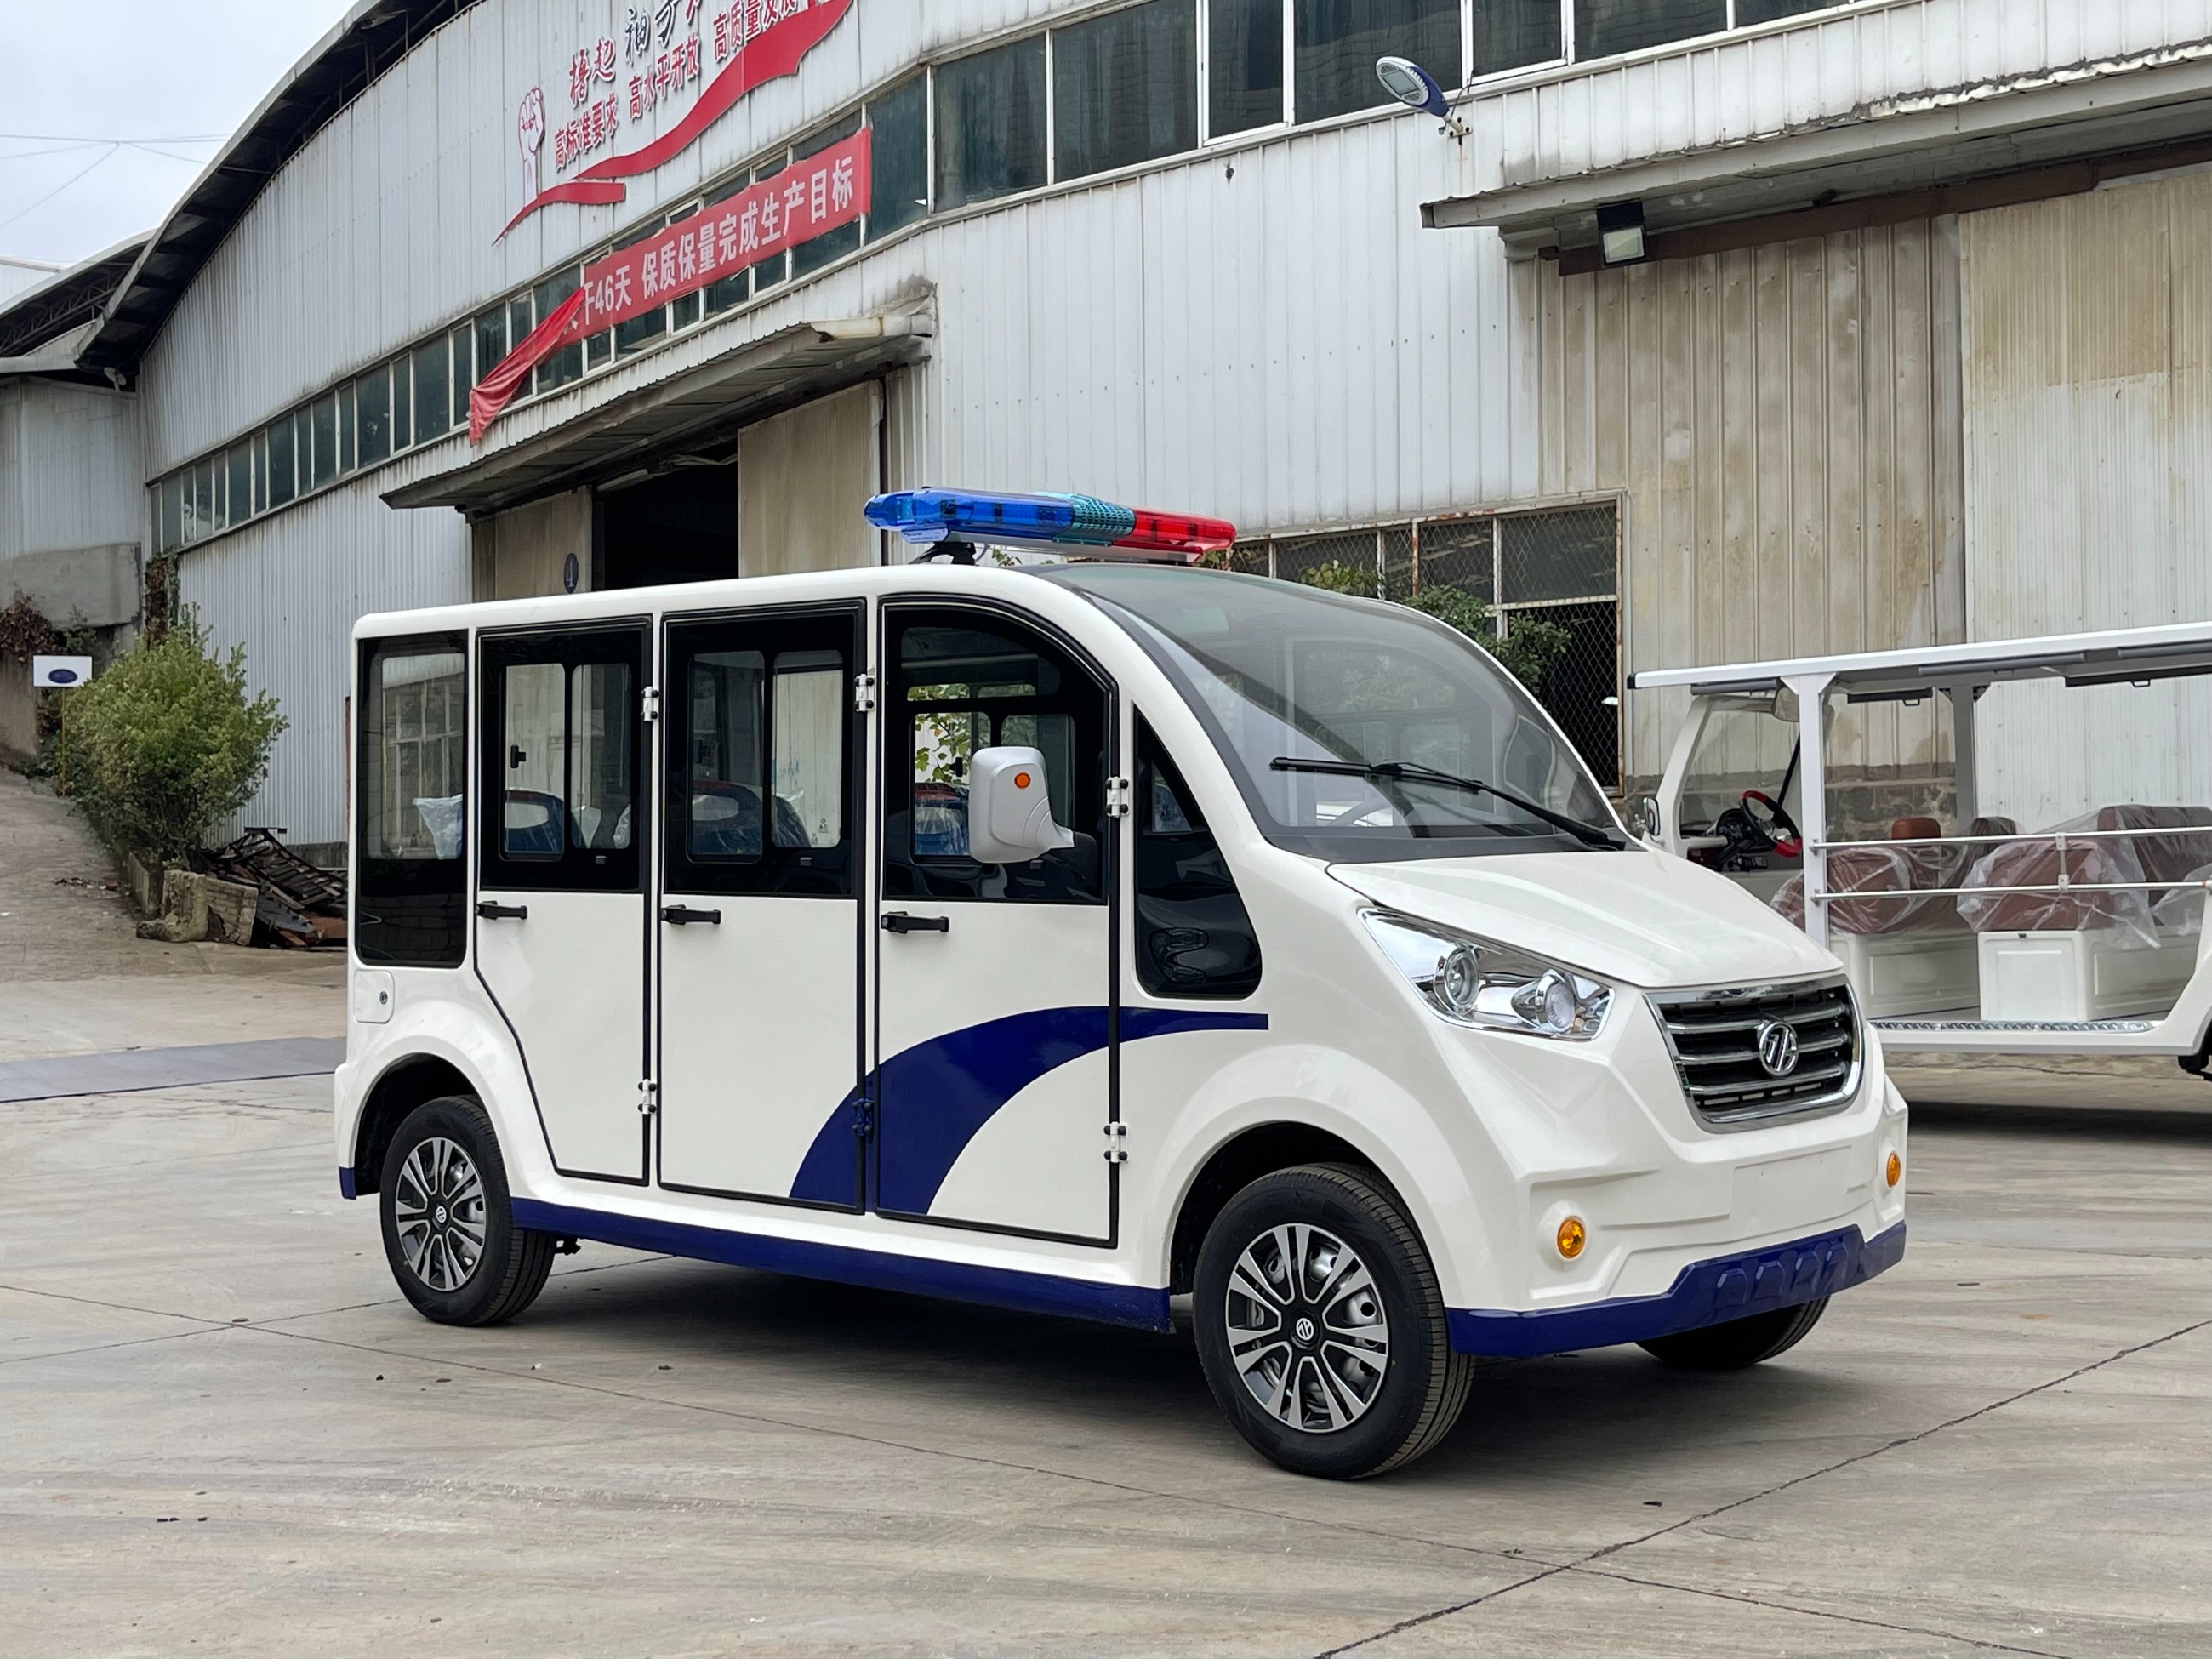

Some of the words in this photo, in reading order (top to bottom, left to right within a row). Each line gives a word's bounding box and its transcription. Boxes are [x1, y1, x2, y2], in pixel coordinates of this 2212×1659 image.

[555, 94, 618, 169] 高标准要求
[628, 36, 699, 119] 高水平开放
[641, 156, 853, 300] 保质保量完成生产目标
